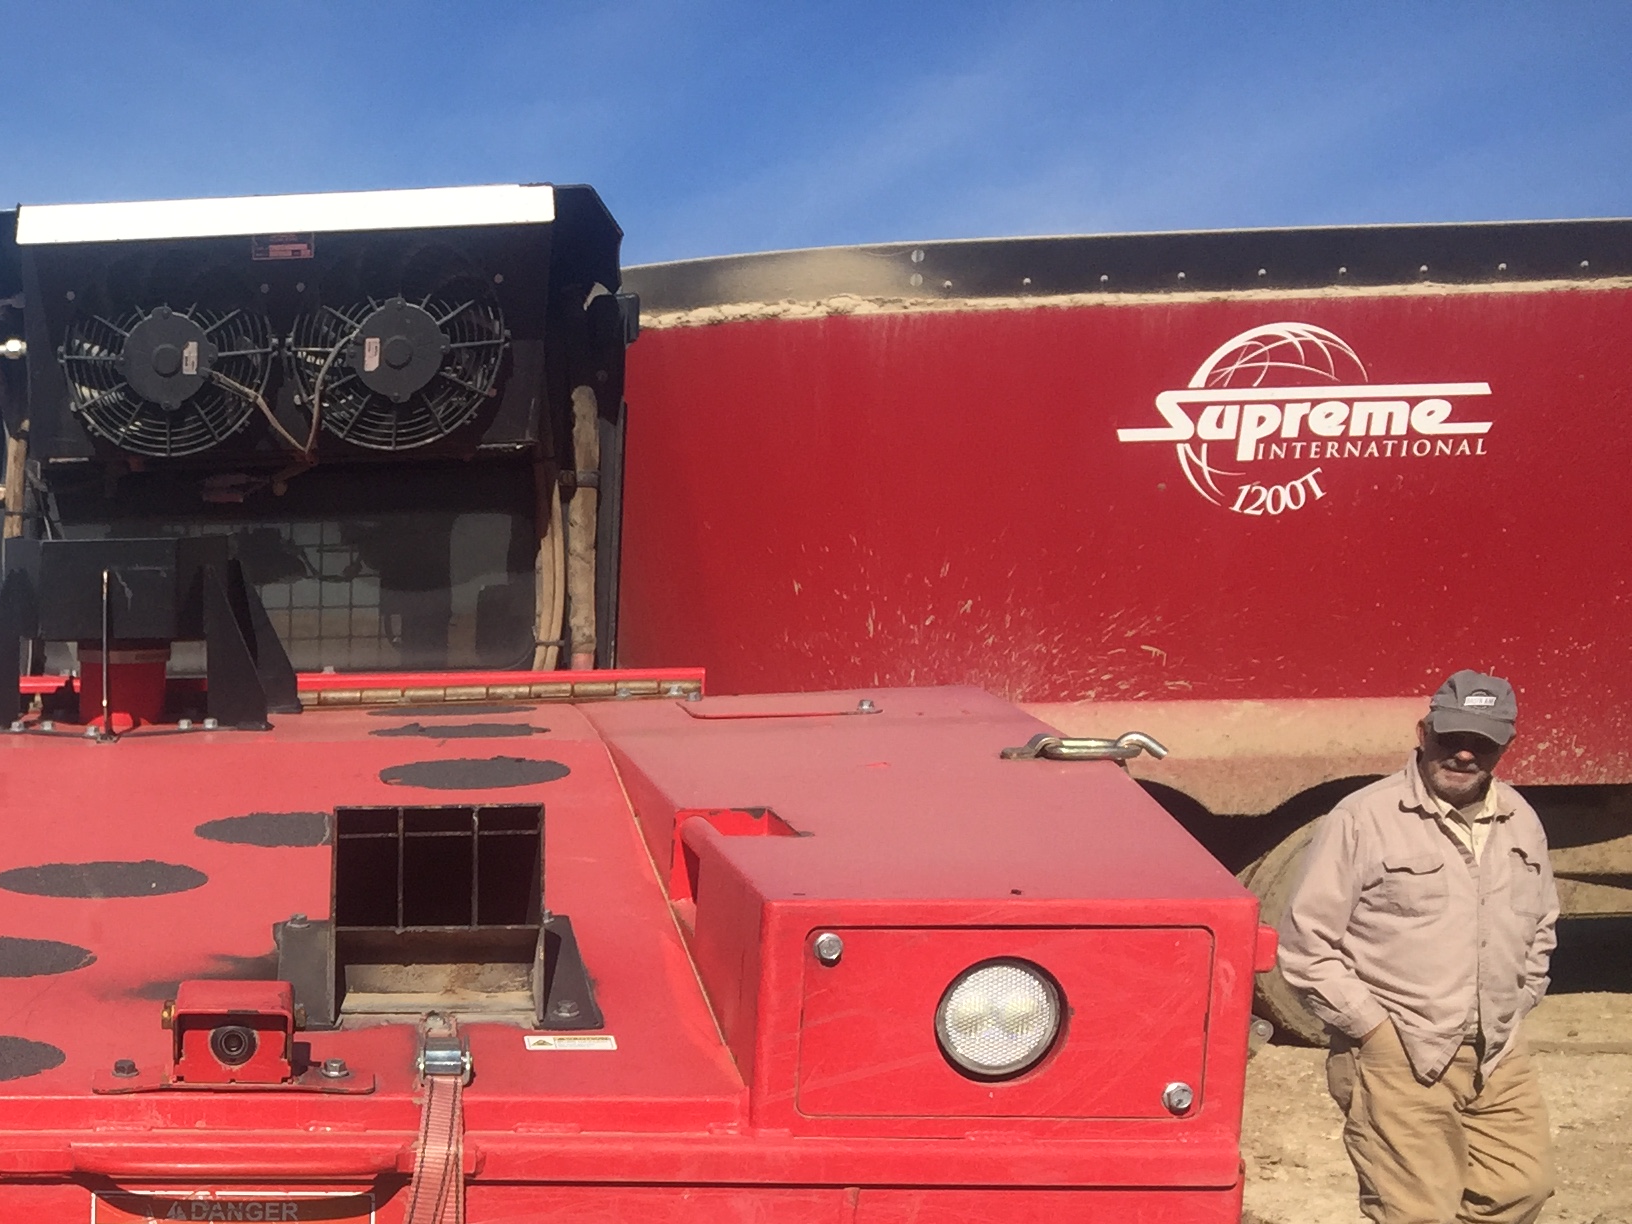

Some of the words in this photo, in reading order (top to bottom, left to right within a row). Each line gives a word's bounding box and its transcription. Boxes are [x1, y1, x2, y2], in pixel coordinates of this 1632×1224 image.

[1117, 382, 1492, 461] Supreme
[1254, 438, 1487, 460] INTERNATIONAL
[1229, 467, 1327, 516] 1200T
[191, 1201, 299, 1221] DANGER
